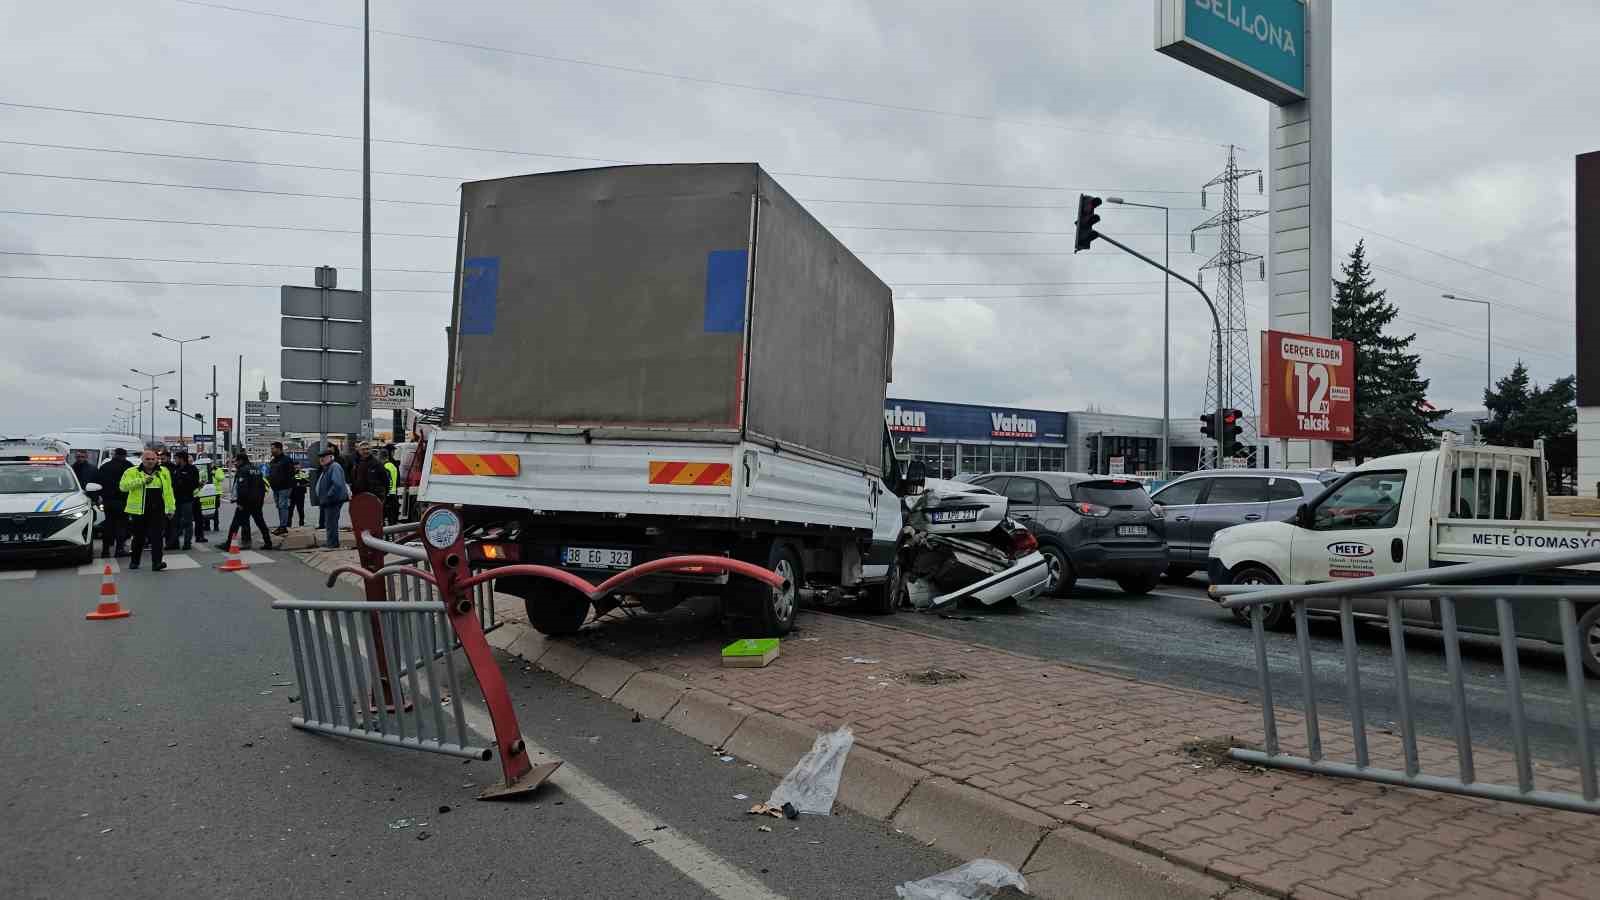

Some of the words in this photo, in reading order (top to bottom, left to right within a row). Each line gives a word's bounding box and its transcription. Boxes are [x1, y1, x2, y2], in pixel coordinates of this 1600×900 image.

[1283, 344, 1314, 358] GERÇEK
[1316, 348, 1340, 360] ELDEN
[1295, 362, 1329, 413] 12
[1320, 402, 1329, 411] AY
[992, 412, 1037, 432] Vatan
[1297, 414, 1330, 431] Taksit
[1473, 534, 1510, 546] METE
[569, 549, 580, 561] 38
[610, 552, 629, 564] 323
[1336, 545, 1364, 553] METE
